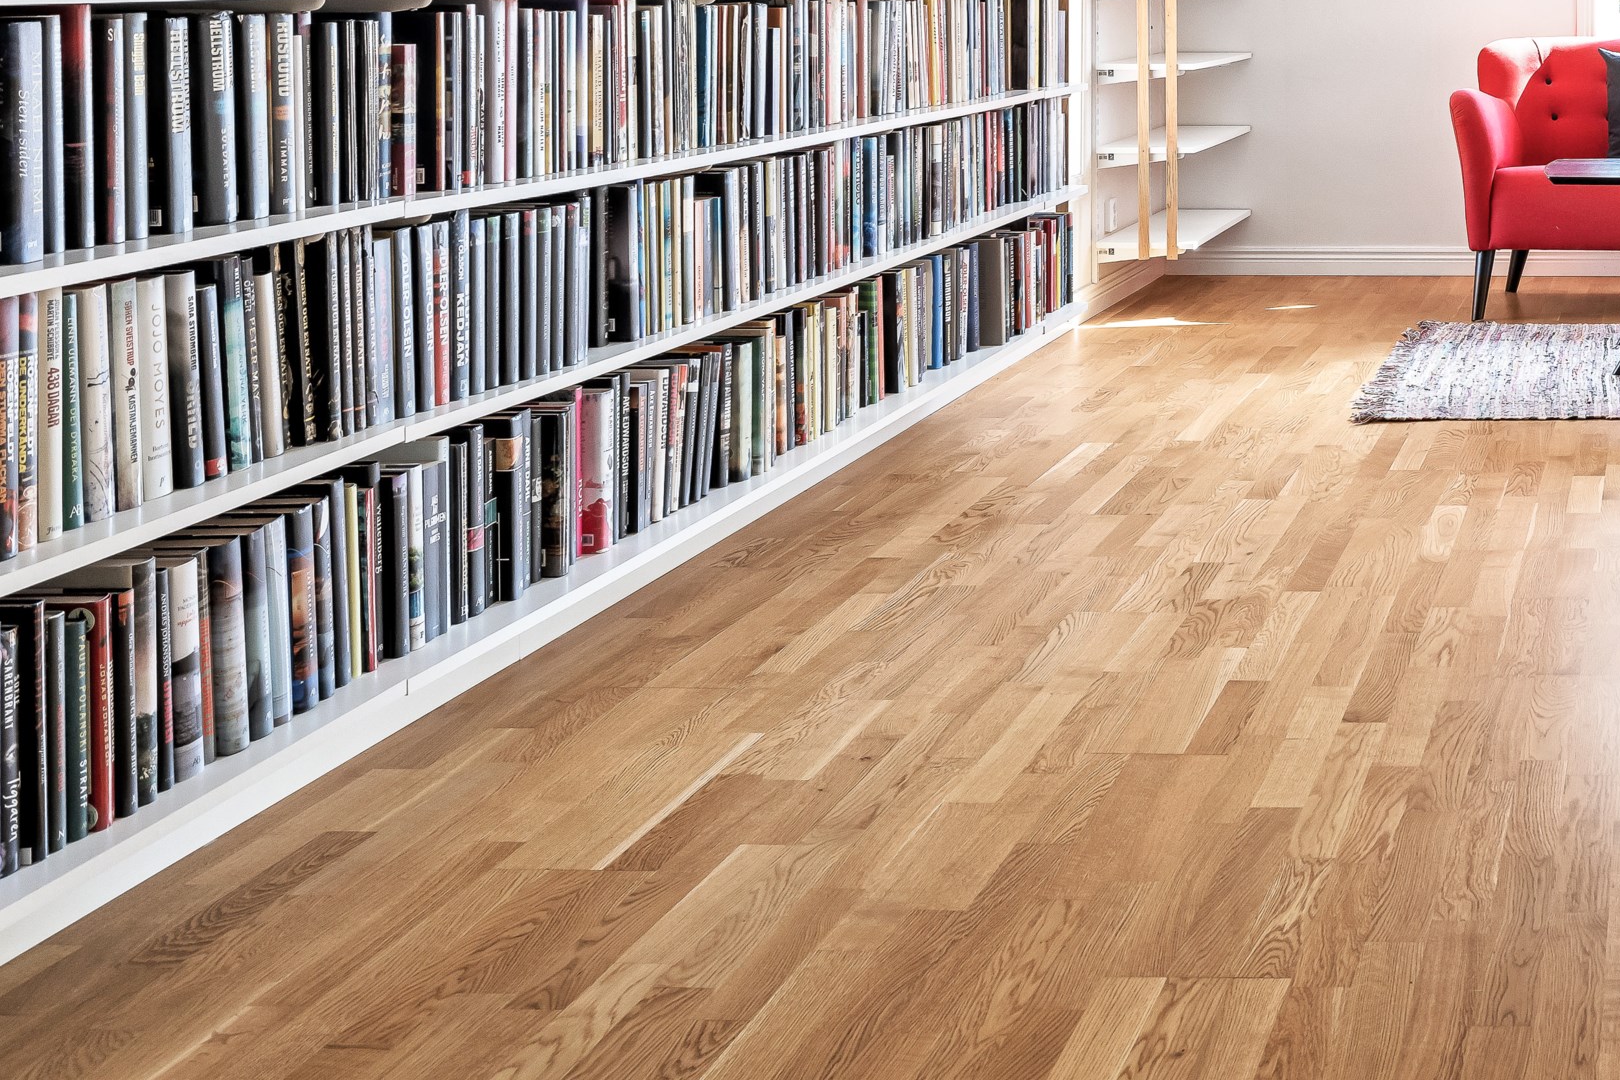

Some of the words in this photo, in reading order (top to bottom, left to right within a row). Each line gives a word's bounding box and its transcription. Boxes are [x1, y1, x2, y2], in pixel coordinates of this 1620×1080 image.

[132, 33, 144, 71] Shuggie
[210, 20, 226, 92] HELLSTRÖM
[277, 22, 289, 98] ROSLUND
[18, 89, 30, 124] Sten
[32, 50, 41, 135] MIKAEL
[134, 74, 145, 96] Bain
[18, 138, 31, 178] siden
[32, 147, 42, 215] NIEMI
[280, 139, 288, 183] TIMMAR
[275, 275, 284, 312] TUSEN
[299, 269, 307, 306] TUSEN
[402, 253, 411, 358] ADLER-OLSEN
[425, 249, 434, 352] ADLER-OLSEN
[439, 246, 448, 346] ADLER-OLSEN
[67, 317, 75, 345] LINN
[125, 301, 134, 325] SØREN
[151, 304, 163, 353] JOJO
[277, 314, 285, 333] OCH
[301, 308, 309, 329] OCH
[345, 322, 351, 335] EN
[357, 322, 363, 335] EN
[456, 293, 464, 367] KEDJAN
[125, 327, 135, 366] SVEISTRUP
[249, 317, 258, 365] PETER
[278, 336, 285, 350] EN
[303, 332, 309, 347] EN
[19, 356, 27, 376] DE
[47, 367, 59, 390] 438
[68, 347, 76, 404] ULLMANN
[251, 370, 260, 401] MAY
[279, 352, 287, 386] NATT
[303, 348, 311, 378] NATT
[47, 391, 60, 428] DAGAR
[69, 407, 78, 427] DET
[153, 363, 165, 430] MOYES
[669, 373, 678, 445] EDWARDSON
[19, 380, 28, 473] UNDERKÄNDA
[127, 395, 138, 464] KASTANJEMANNEN
[622, 416, 630, 477] EDWARDSON
[70, 431, 79, 483] DYRBARA
[375, 503, 384, 574] Wallenberg
[78, 634, 87, 679] PAULA
[200, 618, 212, 673] MICHAEL
[4, 659, 14, 730] SARENBRANT
[99, 663, 107, 702] JONAS
[78, 685, 87, 753] POLANSKI
[202, 677, 214, 737] CONNELLY
[101, 706, 109, 767] JONASSON
[2, 771, 21, 842] Tiggaren
[79, 760, 88, 809] STRAFF
